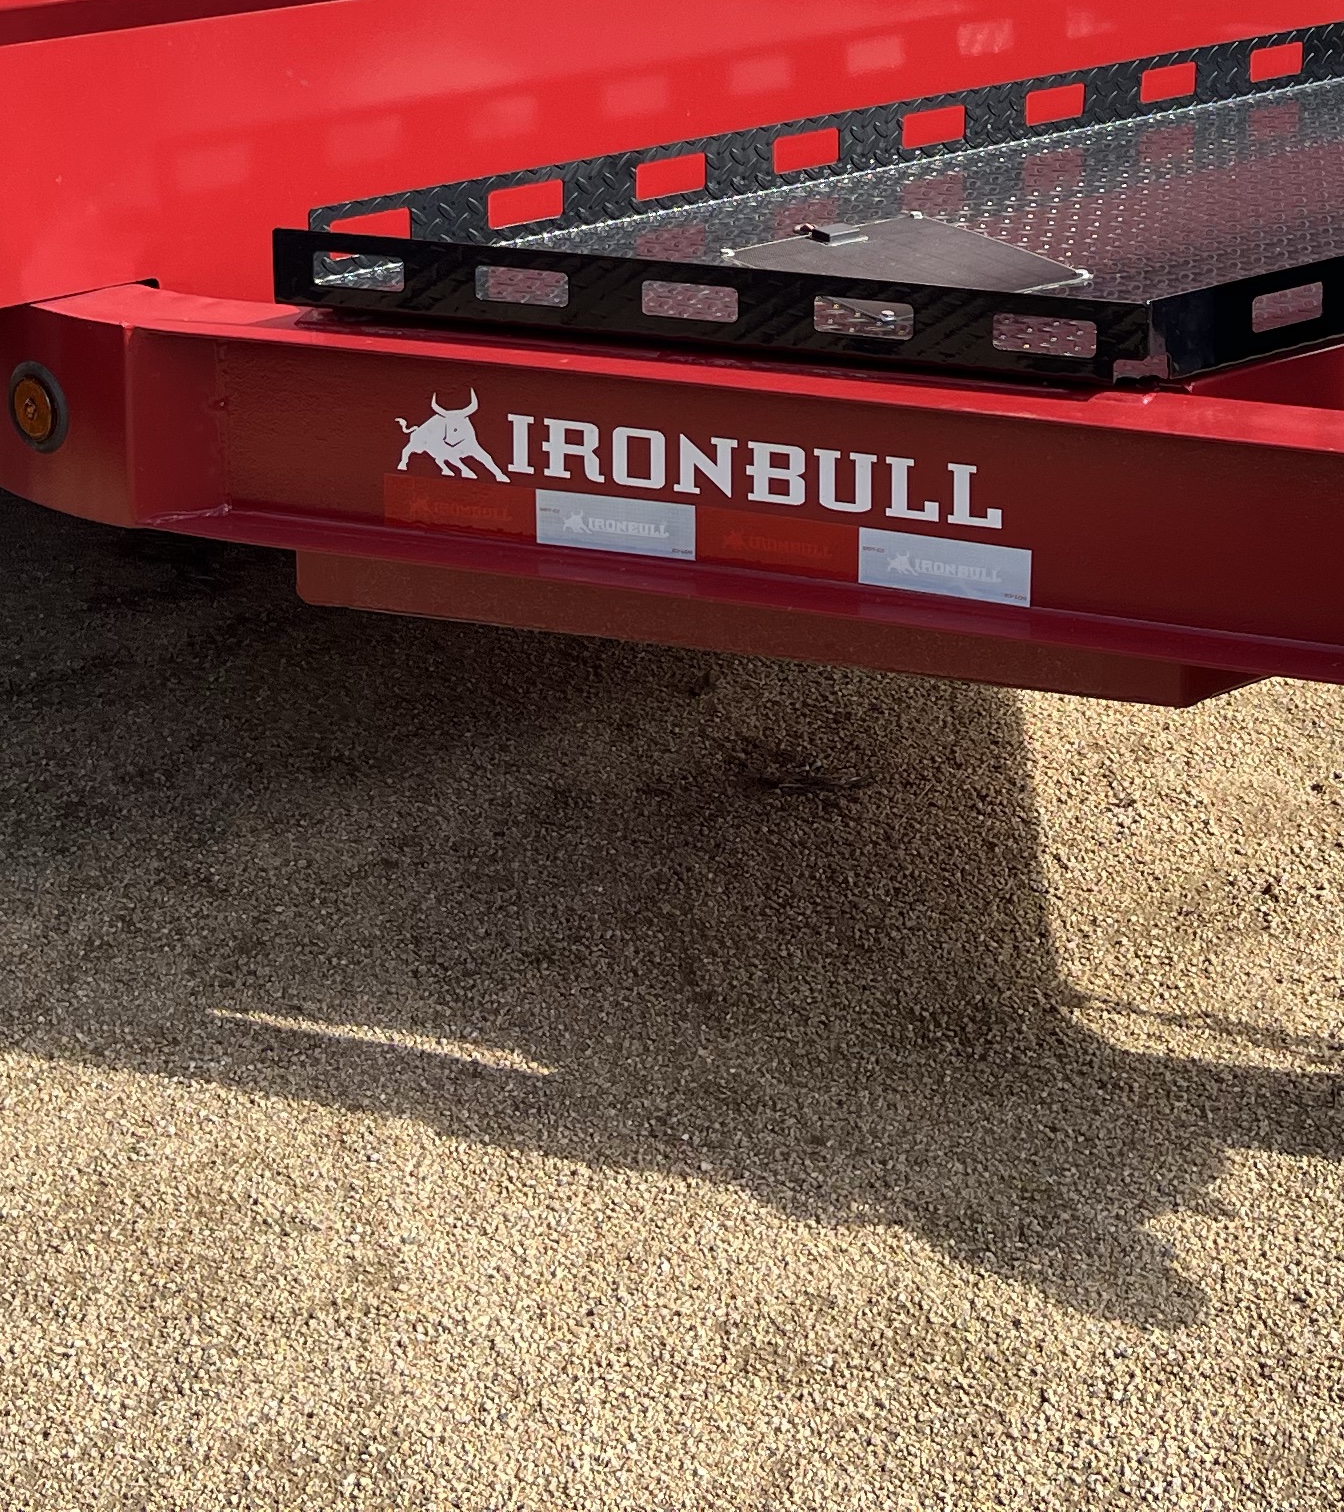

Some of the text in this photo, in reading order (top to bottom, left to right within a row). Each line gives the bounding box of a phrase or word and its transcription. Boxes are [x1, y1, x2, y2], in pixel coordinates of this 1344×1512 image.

[506, 413, 1004, 530] IRONBULL
[587, 517, 670, 539] IRONBULL
[914, 558, 1002, 583] IRONBULL
